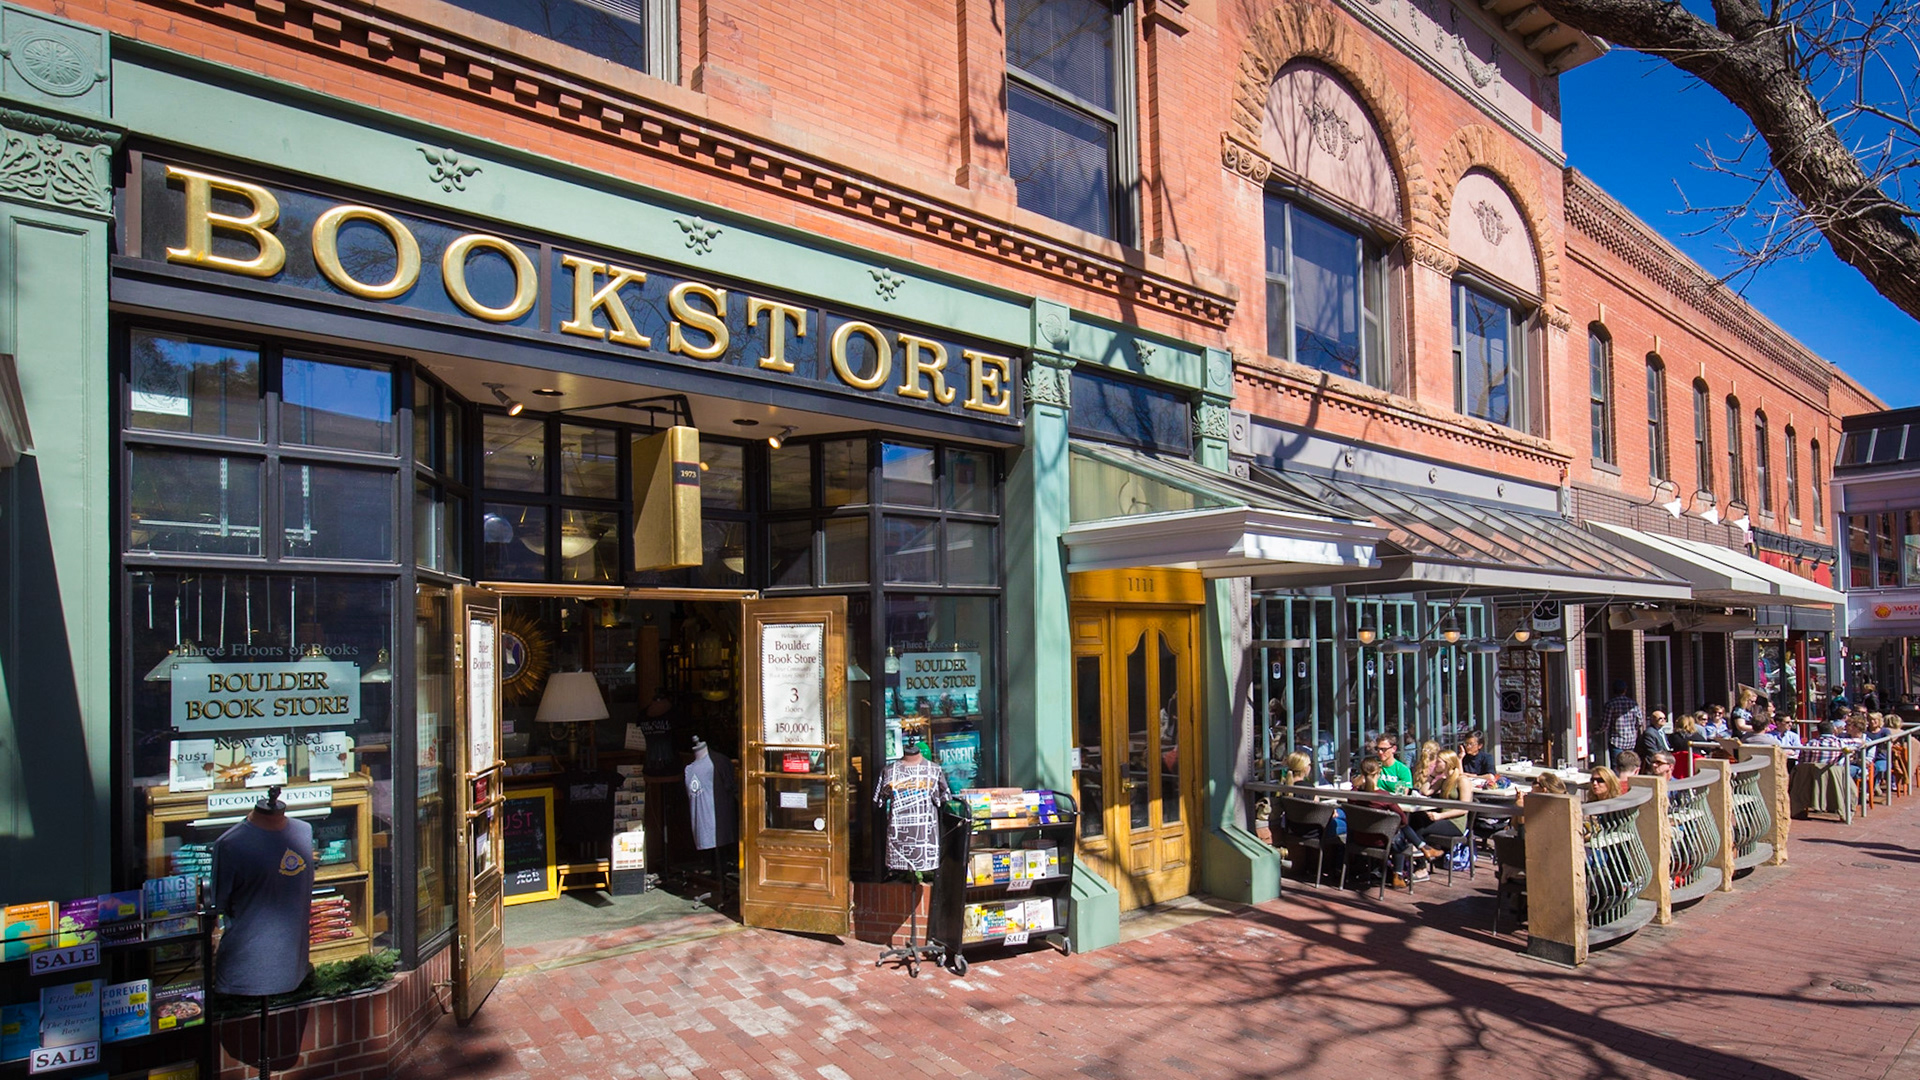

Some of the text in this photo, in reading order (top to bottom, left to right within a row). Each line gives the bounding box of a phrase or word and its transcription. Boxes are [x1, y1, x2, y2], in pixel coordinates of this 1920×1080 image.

[165, 165, 1011, 416] BOOKSTORE
[680, 469, 697, 479] 1973
[1127, 577, 1154, 592] 1111
[177, 643, 359, 658] Three Floors of Books
[774, 640, 811, 651] Boulder
[901, 640, 923, 649] Three
[767, 653, 817, 665] Book Store
[914, 659, 968, 673] BOULDER
[208, 671, 330, 693] BOULDER
[906, 674, 976, 690] BOOK STORE
[789, 686, 800, 704] 3
[185, 695, 350, 721] BOOK STORE
[774, 722, 815, 735] 150,000+
[215, 732, 324, 751] New & Used
[314, 743, 342, 754] RUST
[177, 751, 208, 762] RUST
[251, 748, 281, 759] RUST
[939, 746, 976, 764] DESCENT
[209, 788, 331, 806] UPCOMIN EVENTS
[503, 811, 534, 831] UST
[147, 876, 196, 894] KINGS
[1010, 880, 1031, 890] SALE
[176, 890, 196, 900] ROAD
[1006, 934, 1028, 944] SALE
[36, 948, 96, 970] SALE
[102, 983, 148, 1000] FOREVER
[57, 1001, 88, 1012] Strout
[102, 1003, 148, 1018] MOUNTAIN
[46, 1016, 96, 1030] The Burgess
[61, 1026, 80, 1036] Boys
[36, 1045, 96, 1068] SALE
